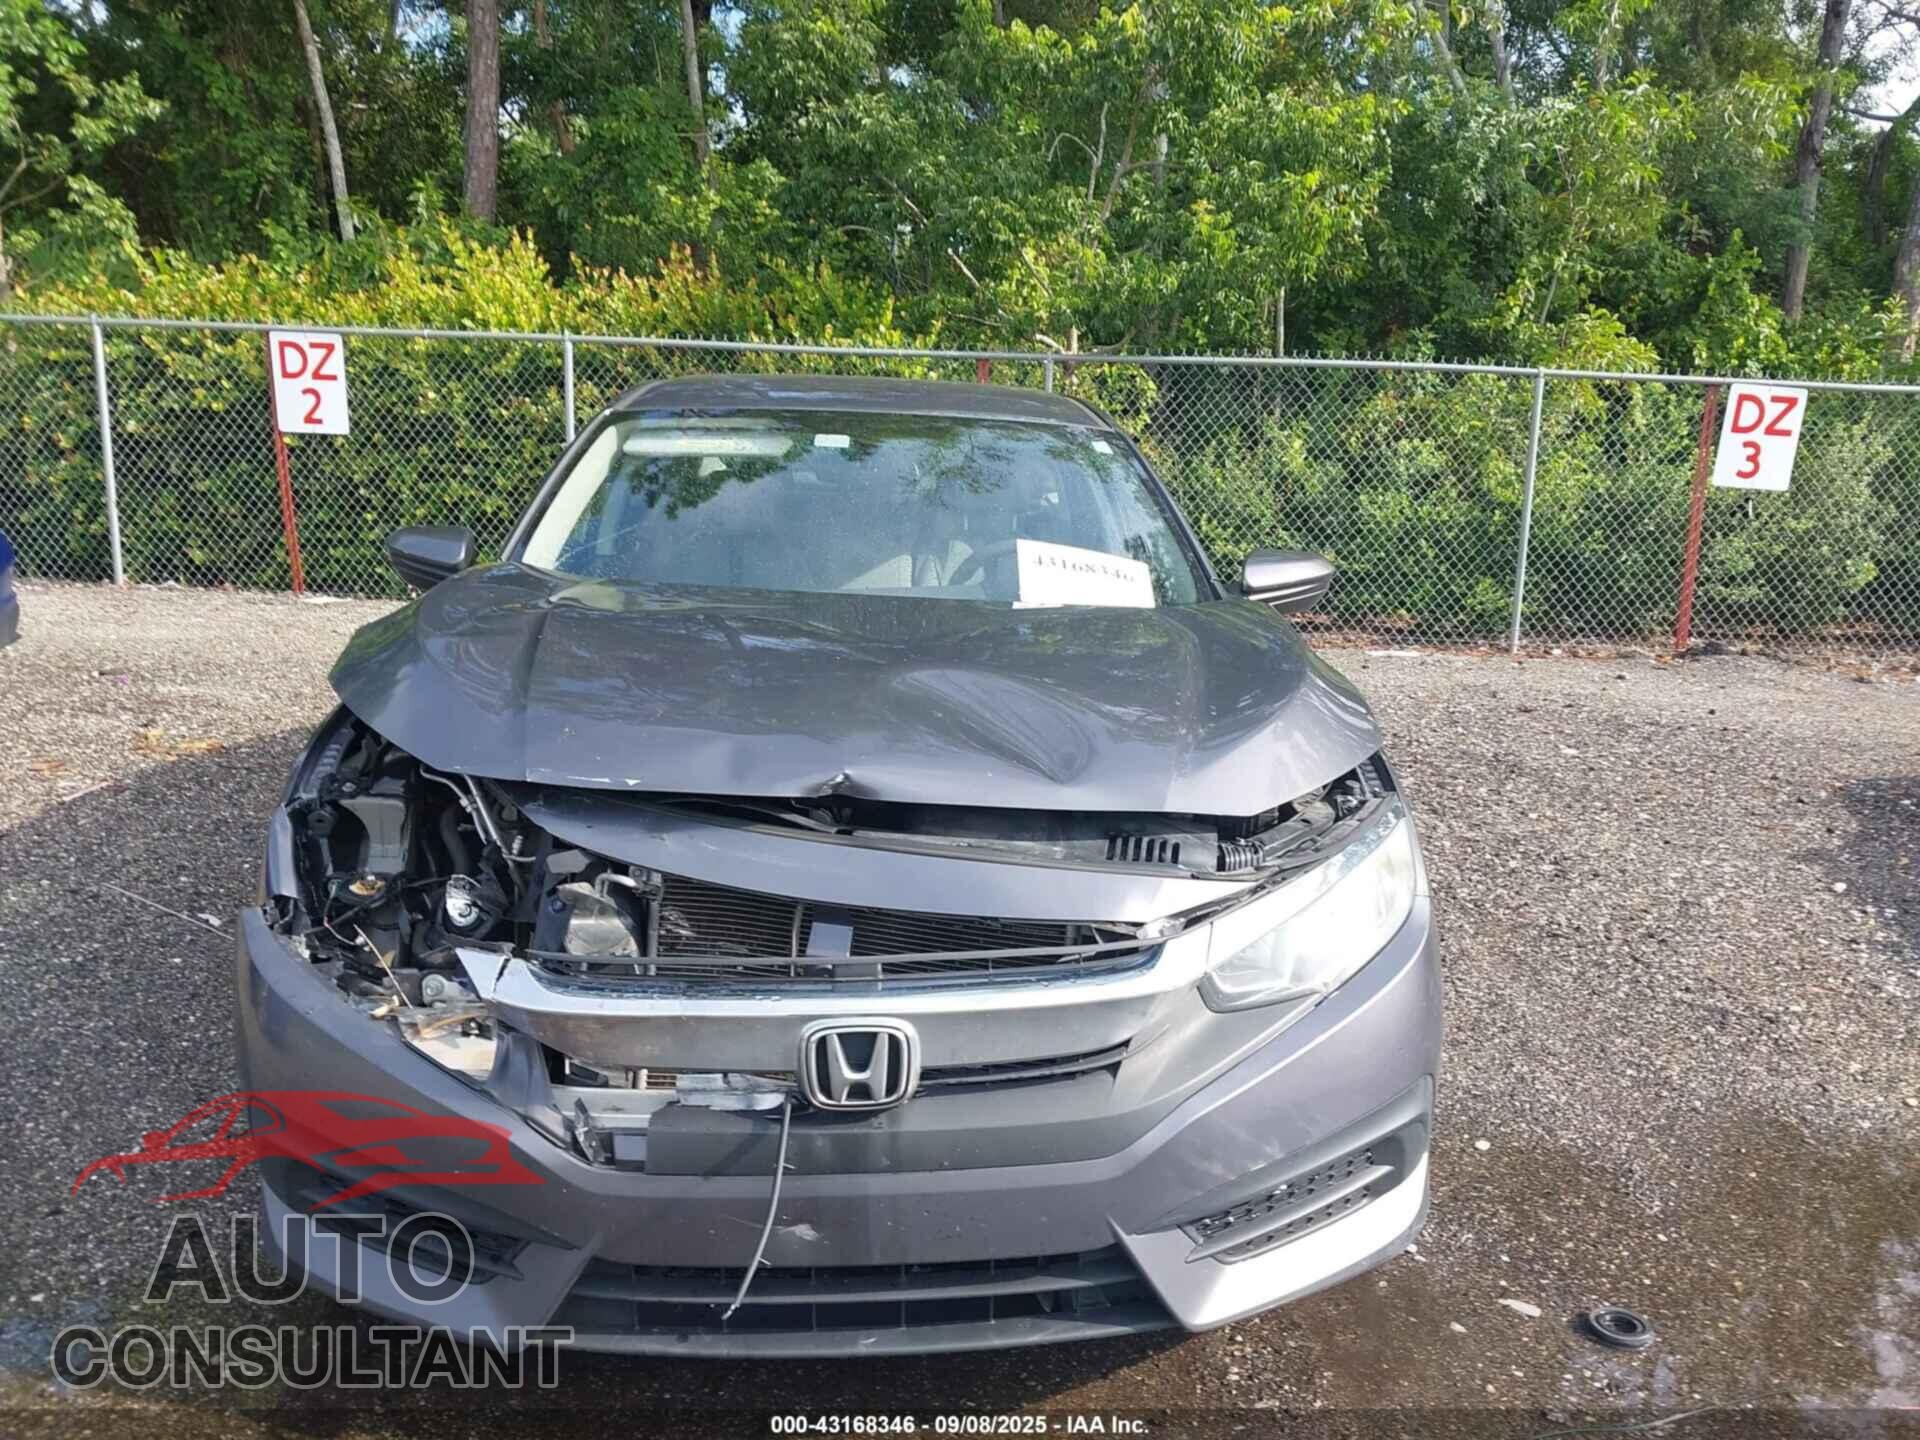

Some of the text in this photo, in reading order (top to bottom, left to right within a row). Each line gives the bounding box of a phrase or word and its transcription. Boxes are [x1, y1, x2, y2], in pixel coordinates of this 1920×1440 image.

[278, 340, 338, 381] DZ
[301, 387, 323, 425] 2
[1731, 393, 1799, 437] DZ
[1735, 440, 1761, 479] 3
